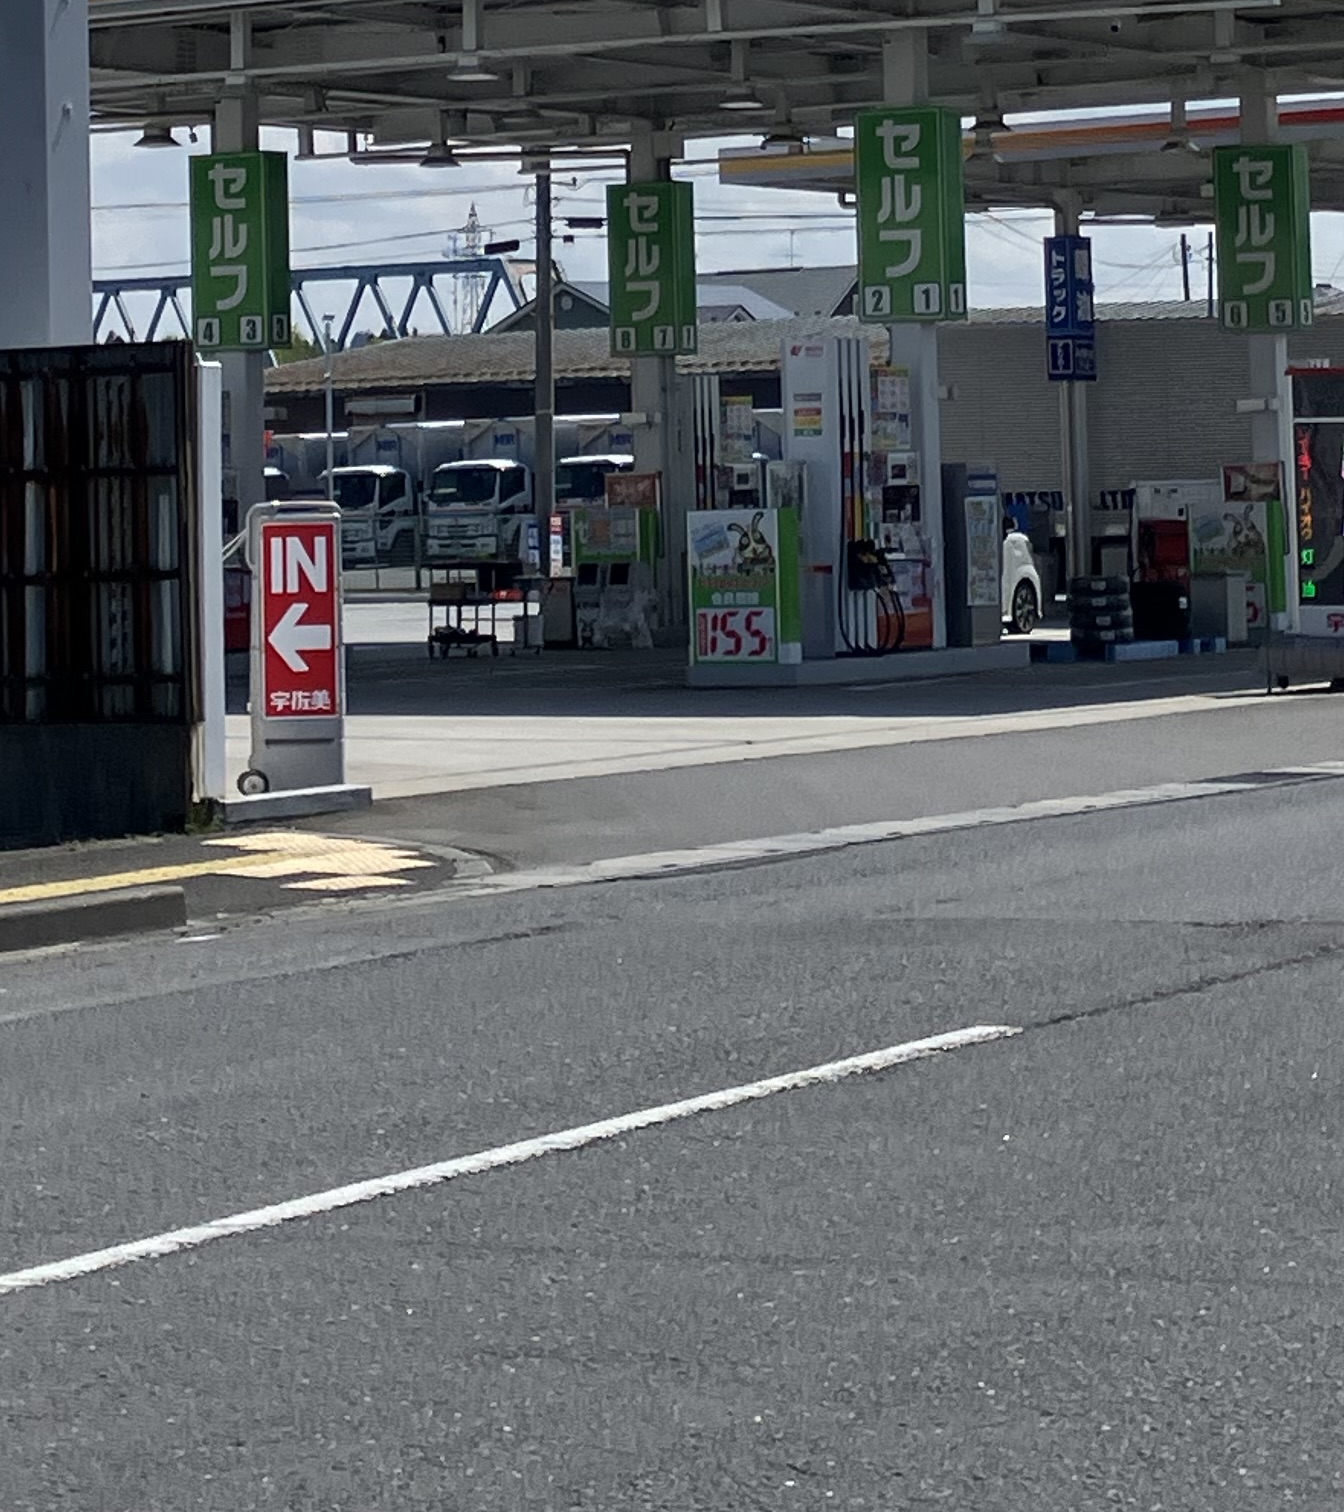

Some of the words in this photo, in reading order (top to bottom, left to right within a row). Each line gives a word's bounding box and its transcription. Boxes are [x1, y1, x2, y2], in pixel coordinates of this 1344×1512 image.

[875, 119, 922, 278] セルフ
[1232, 156, 1275, 296] セルフ
[207, 163, 248, 311] セルフ
[623, 192, 661, 321] セルフ
[871, 289, 884, 313] 2
[922, 286, 931, 311] 1
[1274, 302, 1286, 324] 5
[203, 322, 214, 343] 4
[245, 318, 257, 341] 3
[270, 536, 327, 594] IN
[270, 689, 331, 711] 宇佐美
